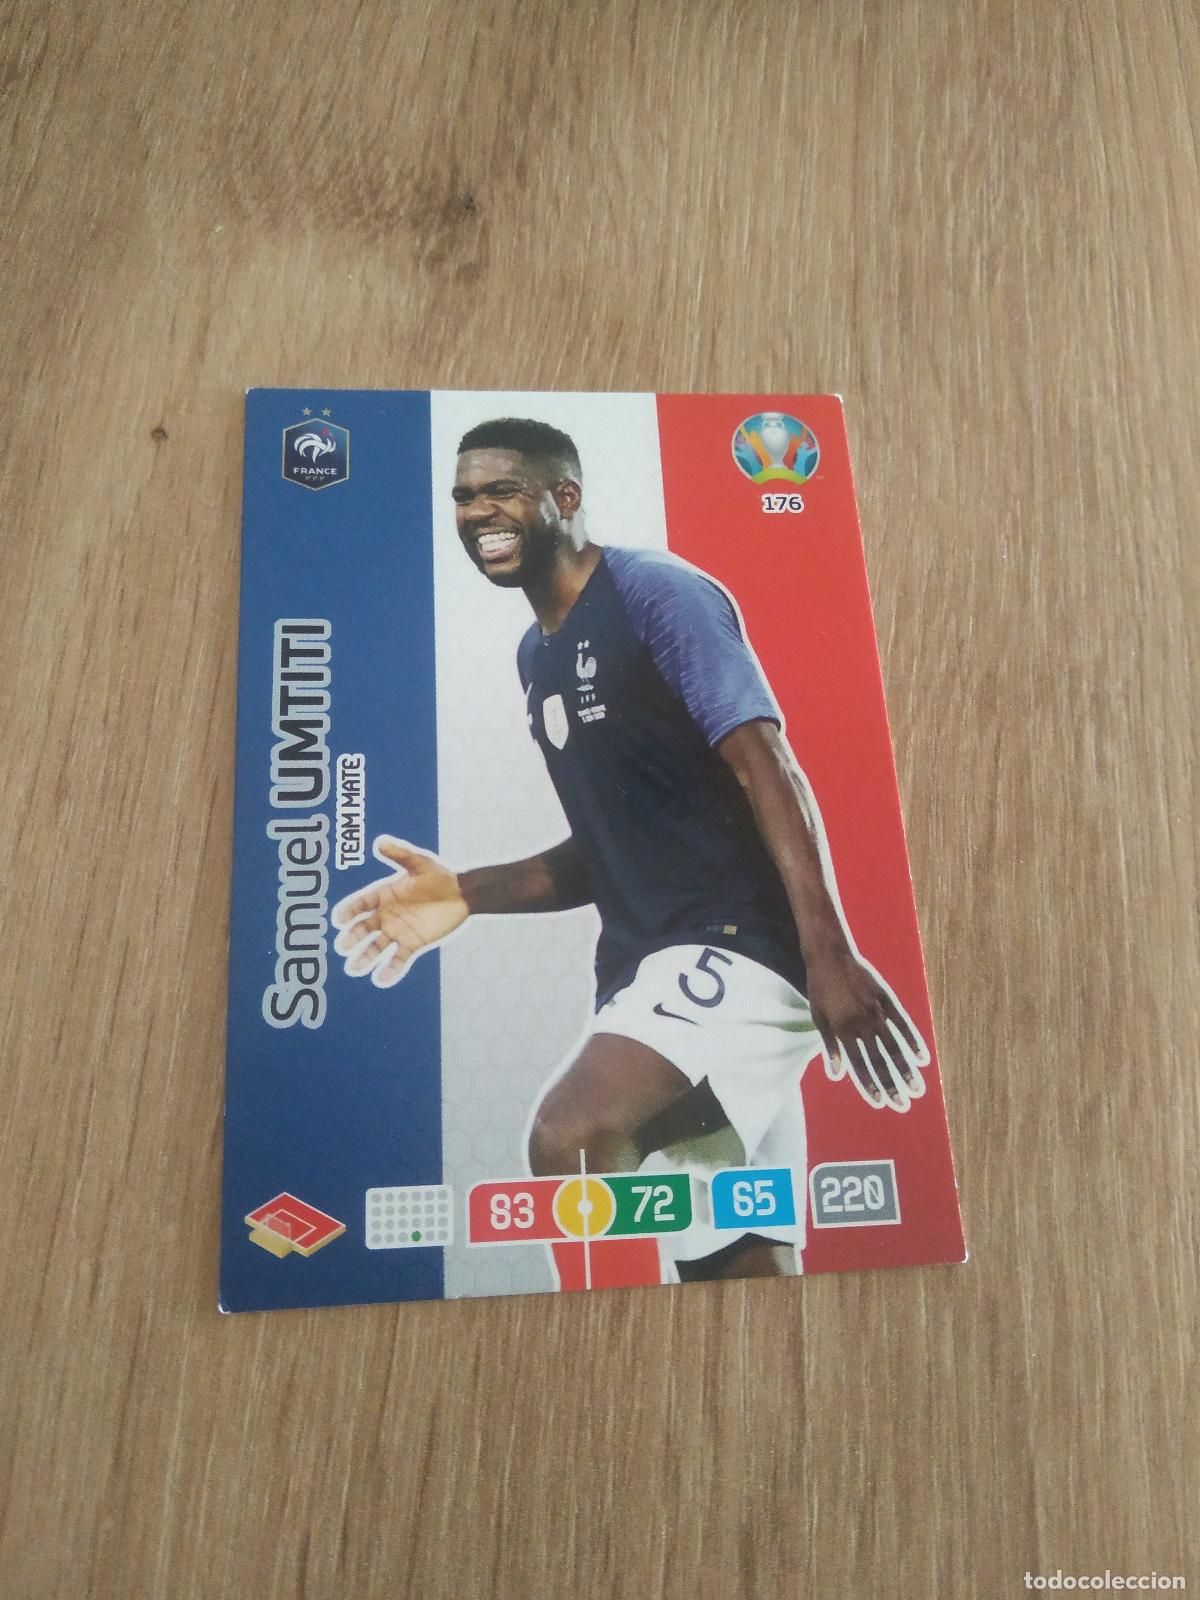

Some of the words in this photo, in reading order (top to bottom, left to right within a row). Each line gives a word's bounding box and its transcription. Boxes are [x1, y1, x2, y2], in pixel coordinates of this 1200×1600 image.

[293, 467, 337, 475] FRANCE
[764, 496, 802, 511] 176
[277, 624, 326, 802] UMTITI
[340, 757, 361, 808] MATE
[340, 812, 361, 866] TEAM
[269, 820, 323, 1022] Samuel
[678, 947, 733, 1009] 5
[489, 1192, 535, 1231] 83
[630, 1185, 676, 1223] 72
[732, 1179, 777, 1217] 65
[819, 1174, 885, 1214] 220
